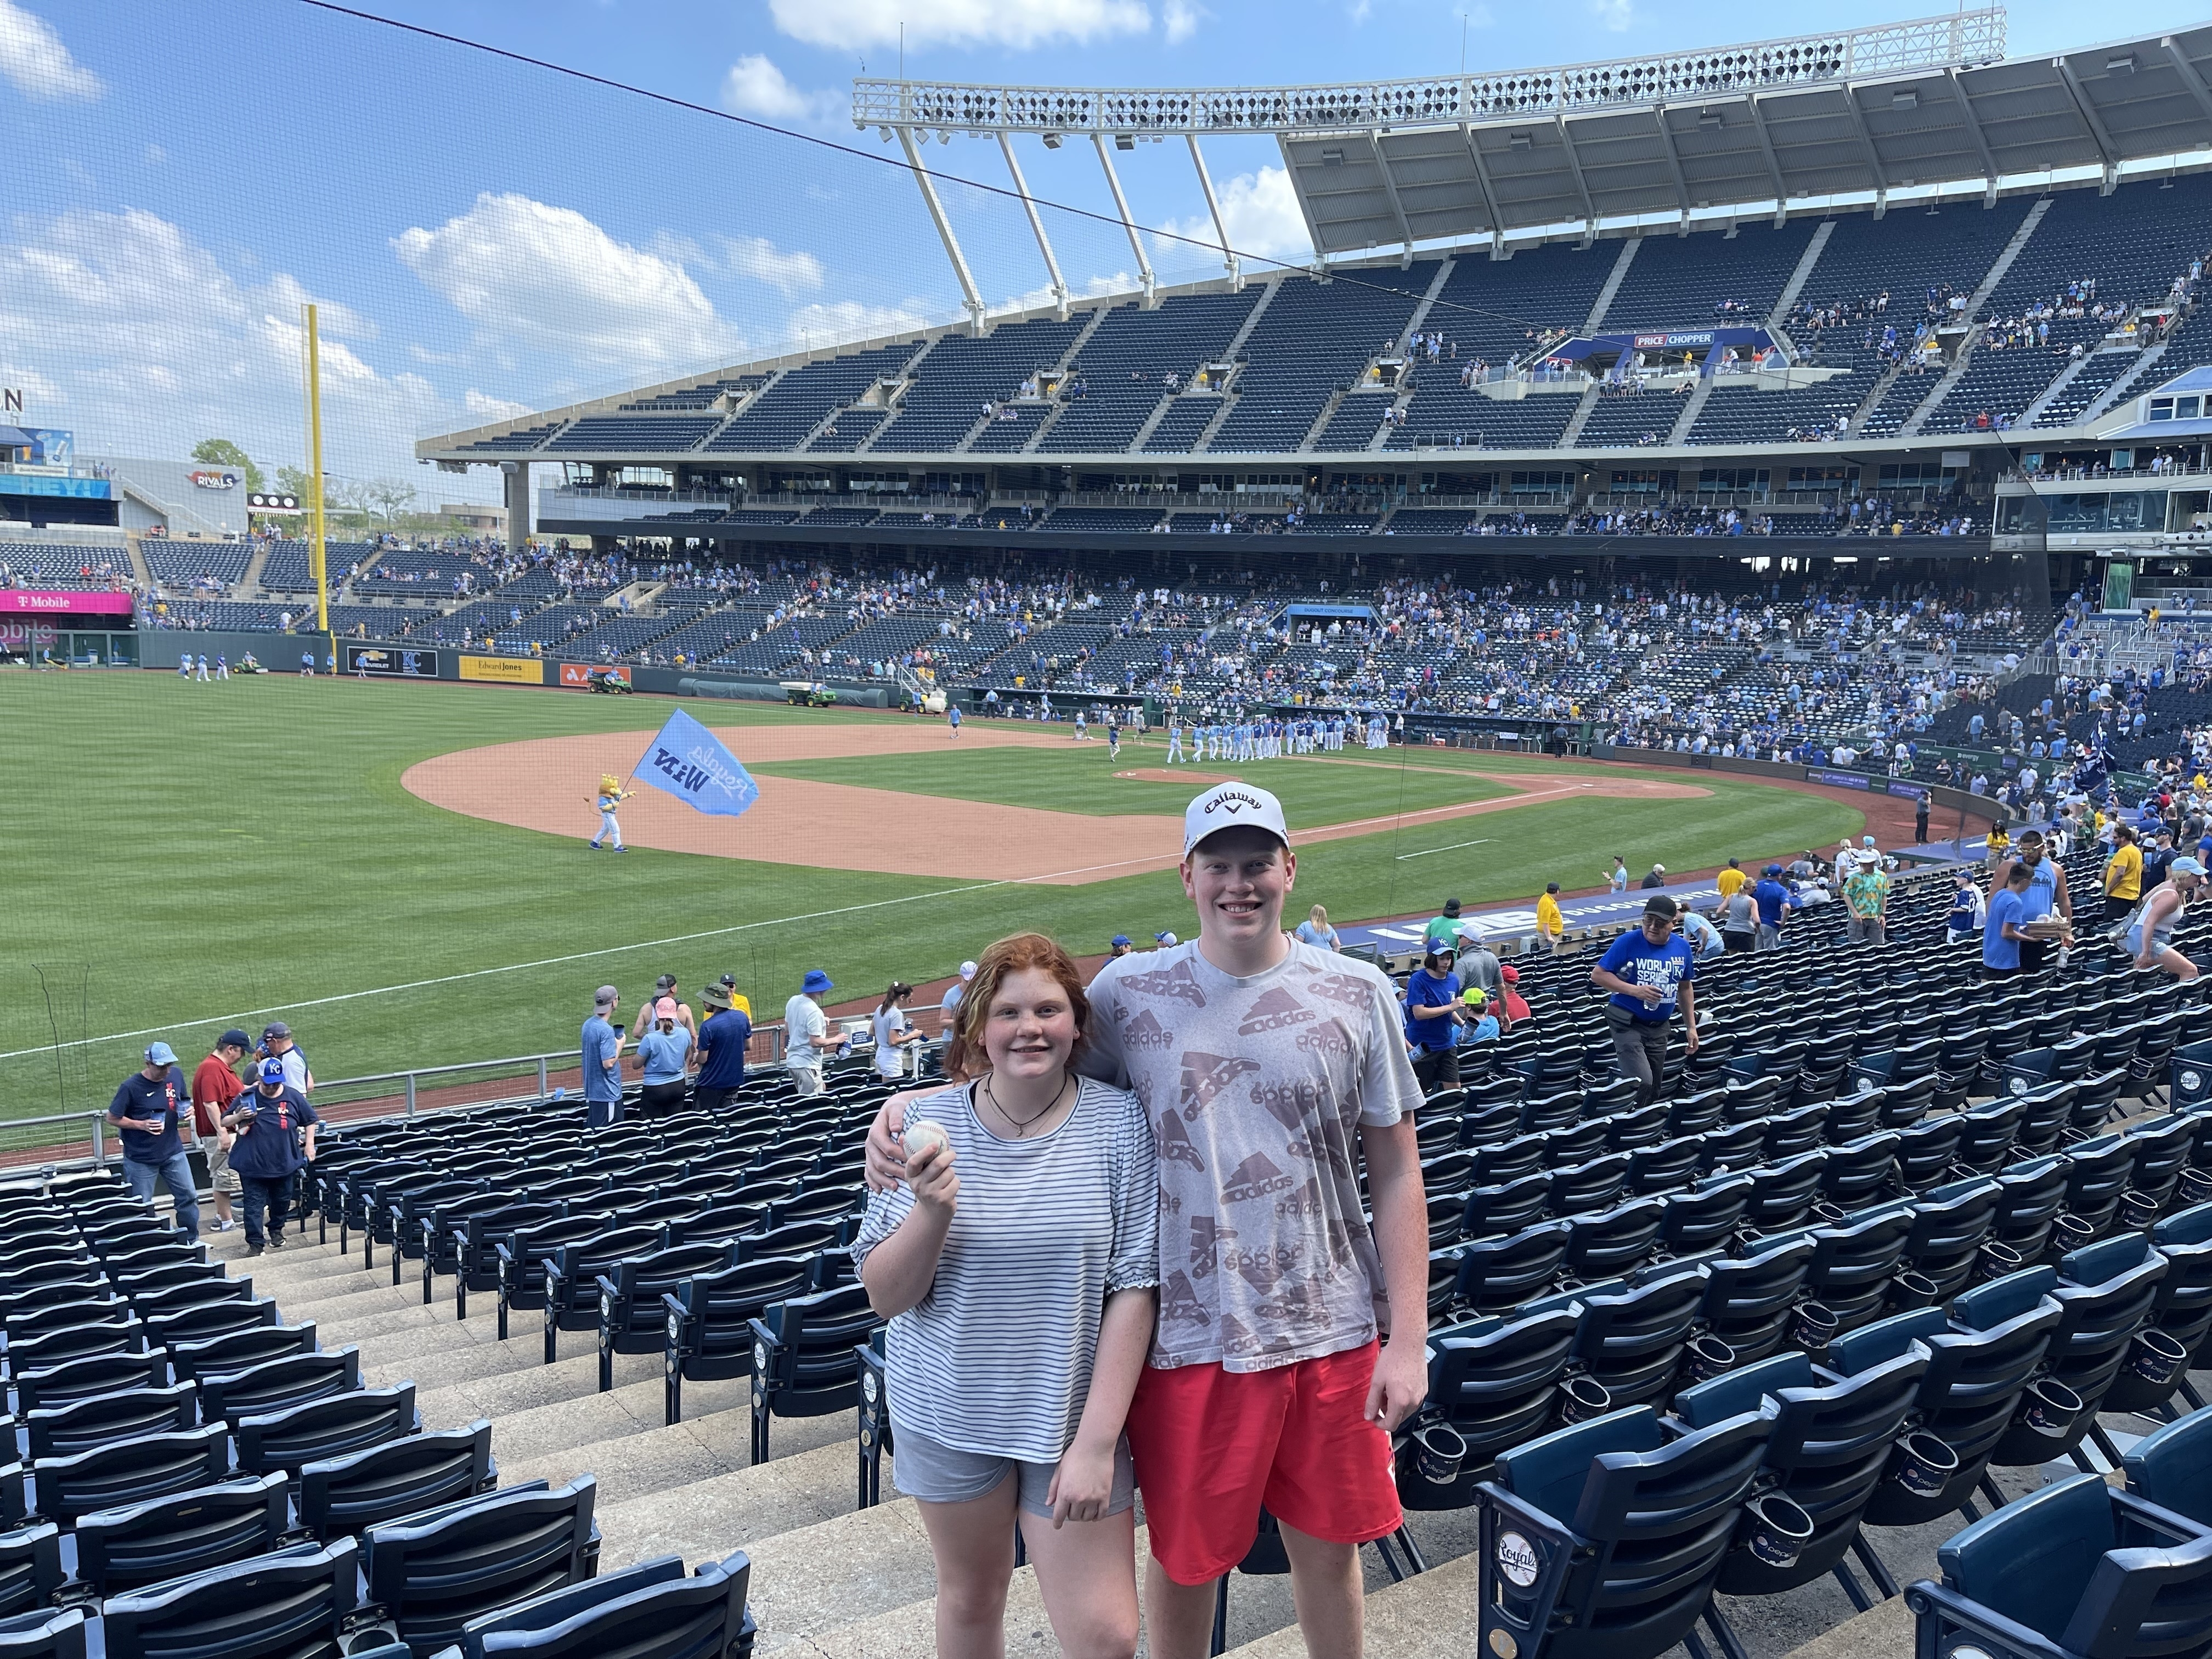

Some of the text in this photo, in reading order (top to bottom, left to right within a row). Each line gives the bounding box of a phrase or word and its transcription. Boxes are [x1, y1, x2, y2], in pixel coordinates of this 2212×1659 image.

[1638, 334, 1712, 346] PRICE CHOPPER
[198, 476, 233, 487] RIVALS
[30, 596, 70, 608] Mobile
[478, 661, 522, 671] Edward Jones
[1204, 791, 1262, 814] Callaway
[1570, 898, 1648, 916] DUGOU
[1437, 938, 1448, 946] KC
[1636, 957, 1672, 973] WORLD
[1637, 970, 1670, 984] SERIES
[1674, 966, 1684, 978] KC
[1238, 1009, 1316, 1036] adidas
[1122, 1030, 1173, 1050] adidas
[269, 1063, 281, 1074] KC
[1220, 1176, 1294, 1205] adidas
[2151, 1365, 2170, 1374] pepsi
[863, 1432, 868, 1443] S
[1426, 1464, 1446, 1475] pepsi
[1917, 1478, 1941, 1487] pepsi
[1499, 1539, 1537, 1571] Royals
[1767, 1547, 1792, 1558] pepsi
